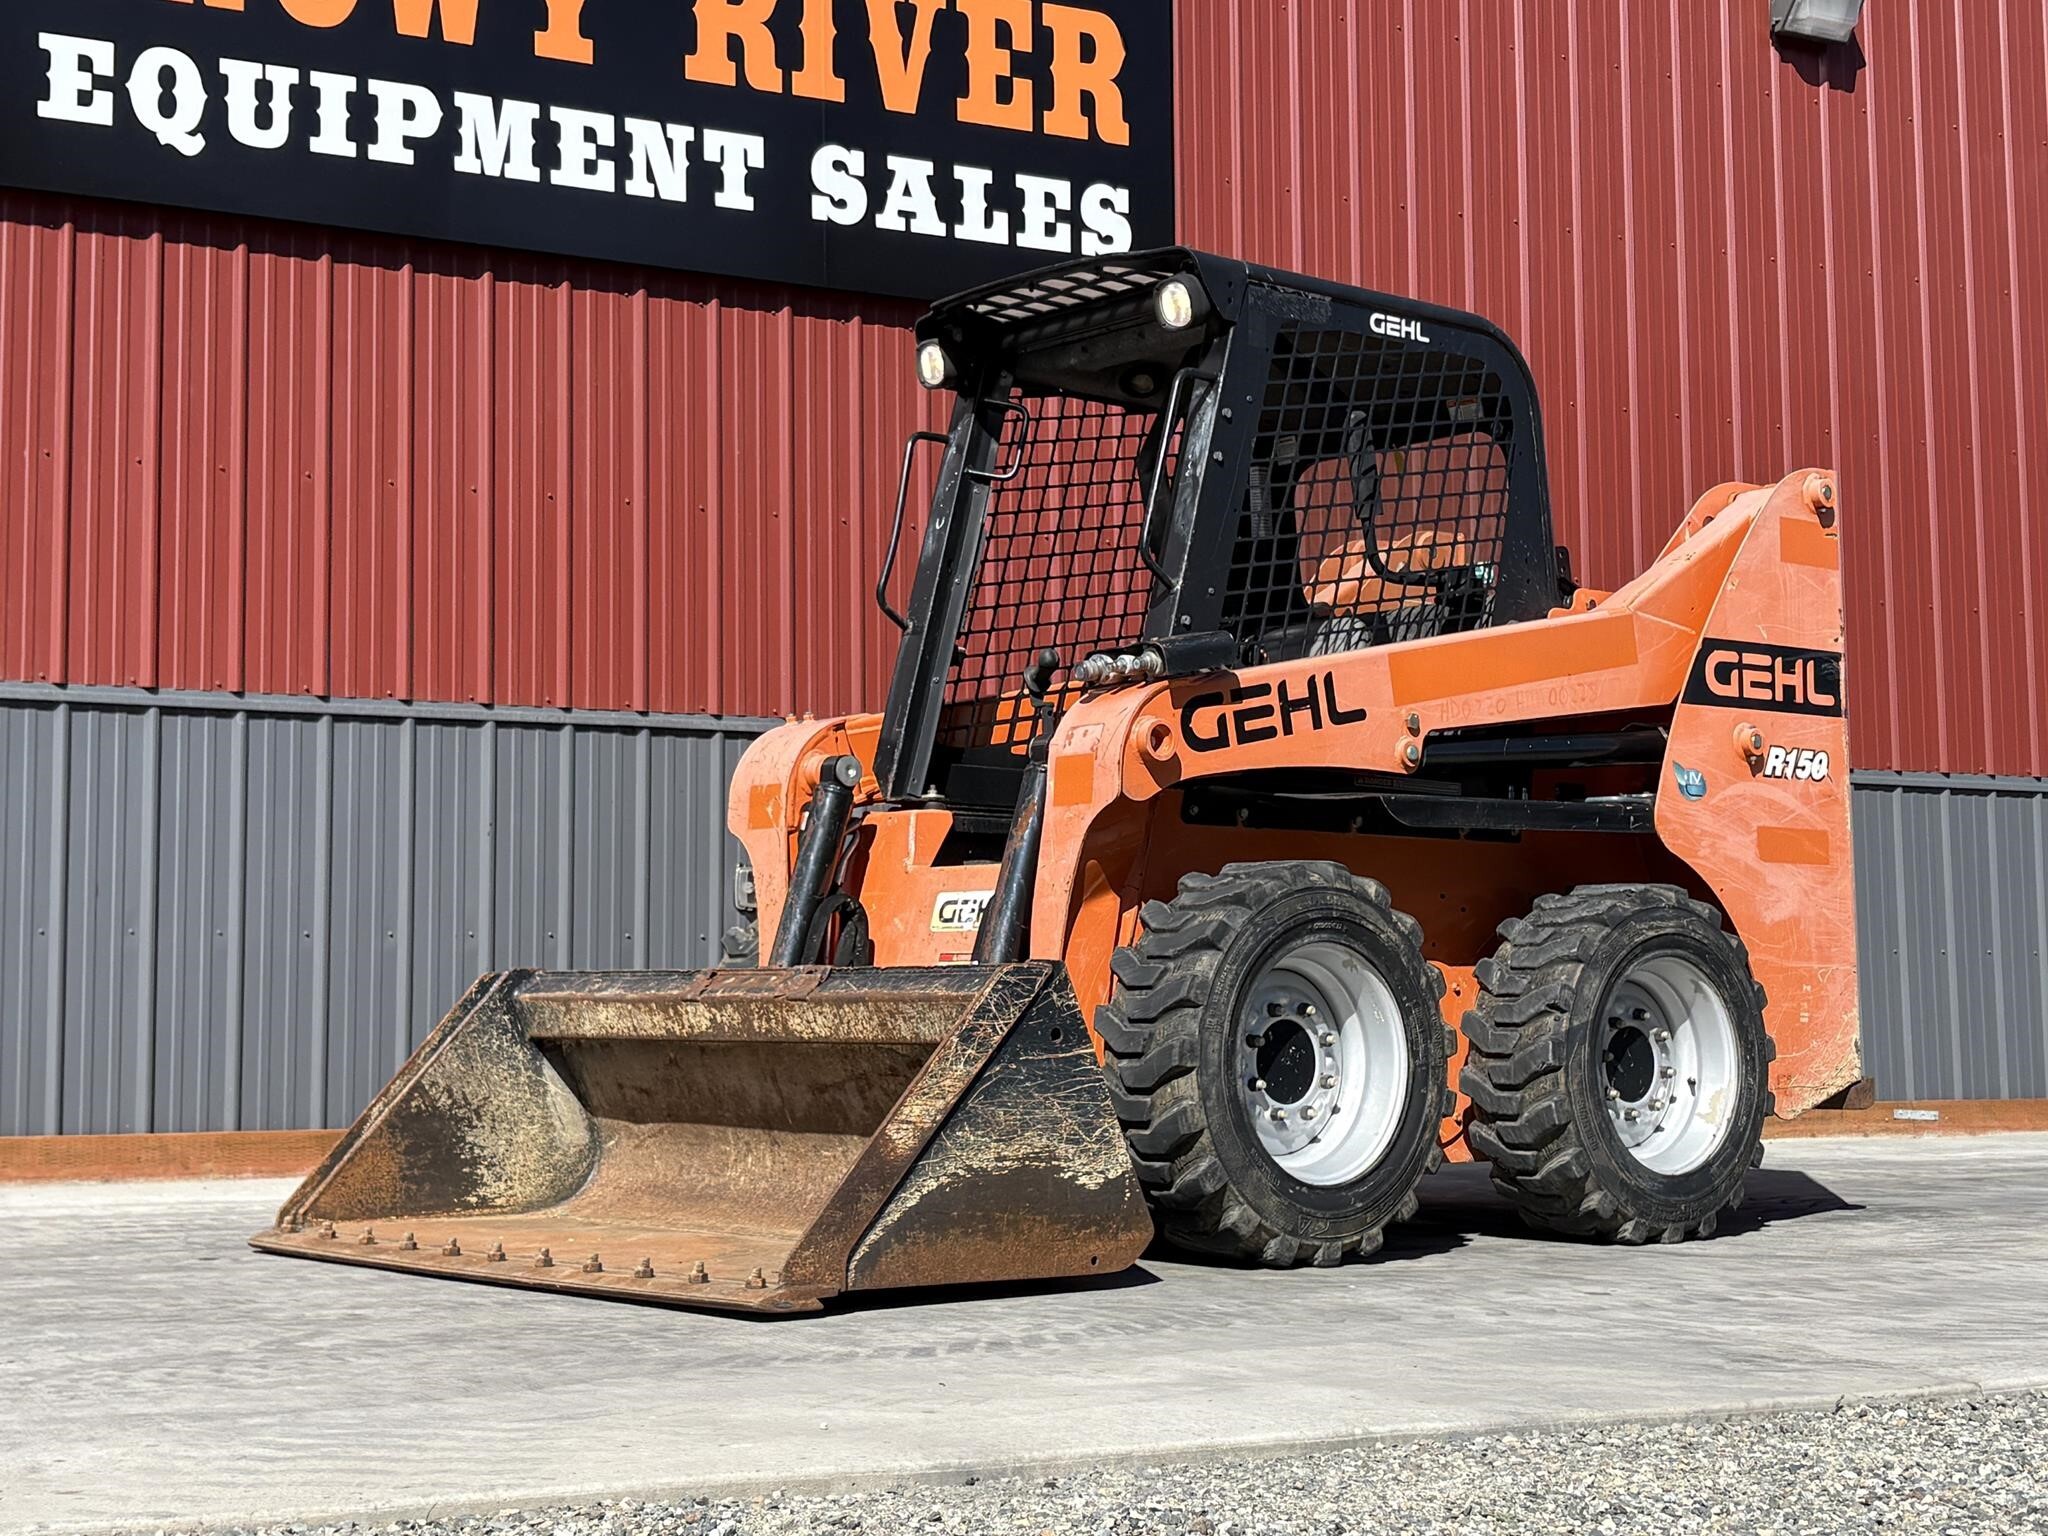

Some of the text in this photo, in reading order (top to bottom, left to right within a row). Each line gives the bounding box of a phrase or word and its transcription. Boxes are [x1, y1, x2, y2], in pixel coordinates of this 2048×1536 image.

[685, 0, 1130, 146] RIVER
[37, 32, 765, 211] EQUIPMENT
[810, 144, 1133, 257] SALES
[1369, 312, 1431, 343] GEHL
[1705, 649, 1835, 706] GEHL
[1180, 671, 1367, 752] GEHL
[1763, 745, 1830, 782] R150
[939, 899, 986, 923] GEH
